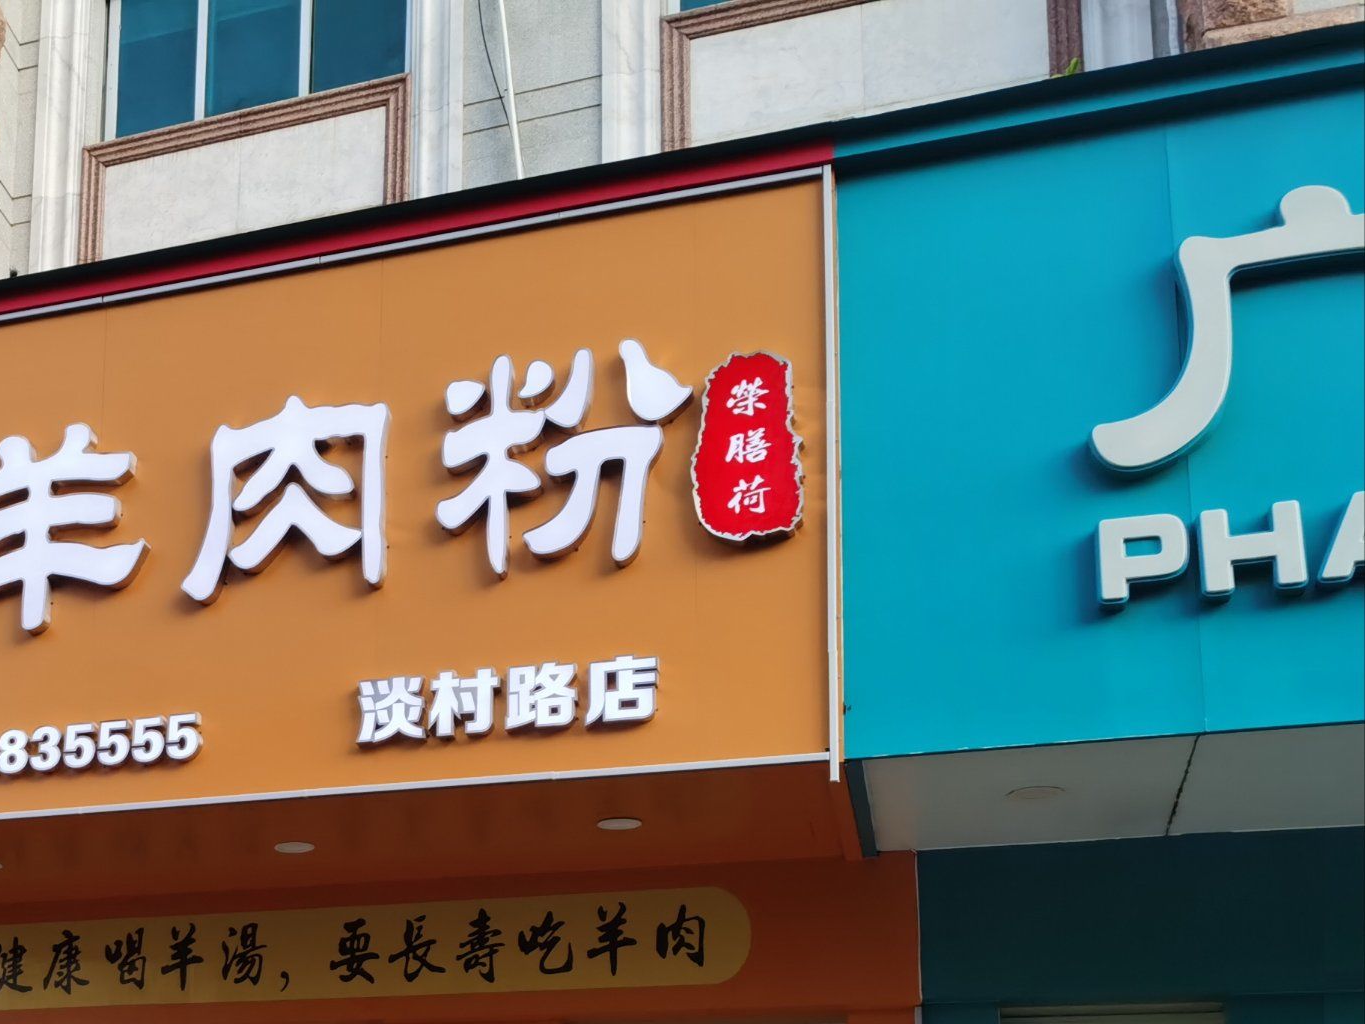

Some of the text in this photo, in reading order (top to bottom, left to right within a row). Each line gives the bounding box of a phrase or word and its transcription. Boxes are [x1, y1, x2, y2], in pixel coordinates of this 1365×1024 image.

[1096, 490, 1365, 604] PHA
[355, 656, 660, 745] 淡村路店
